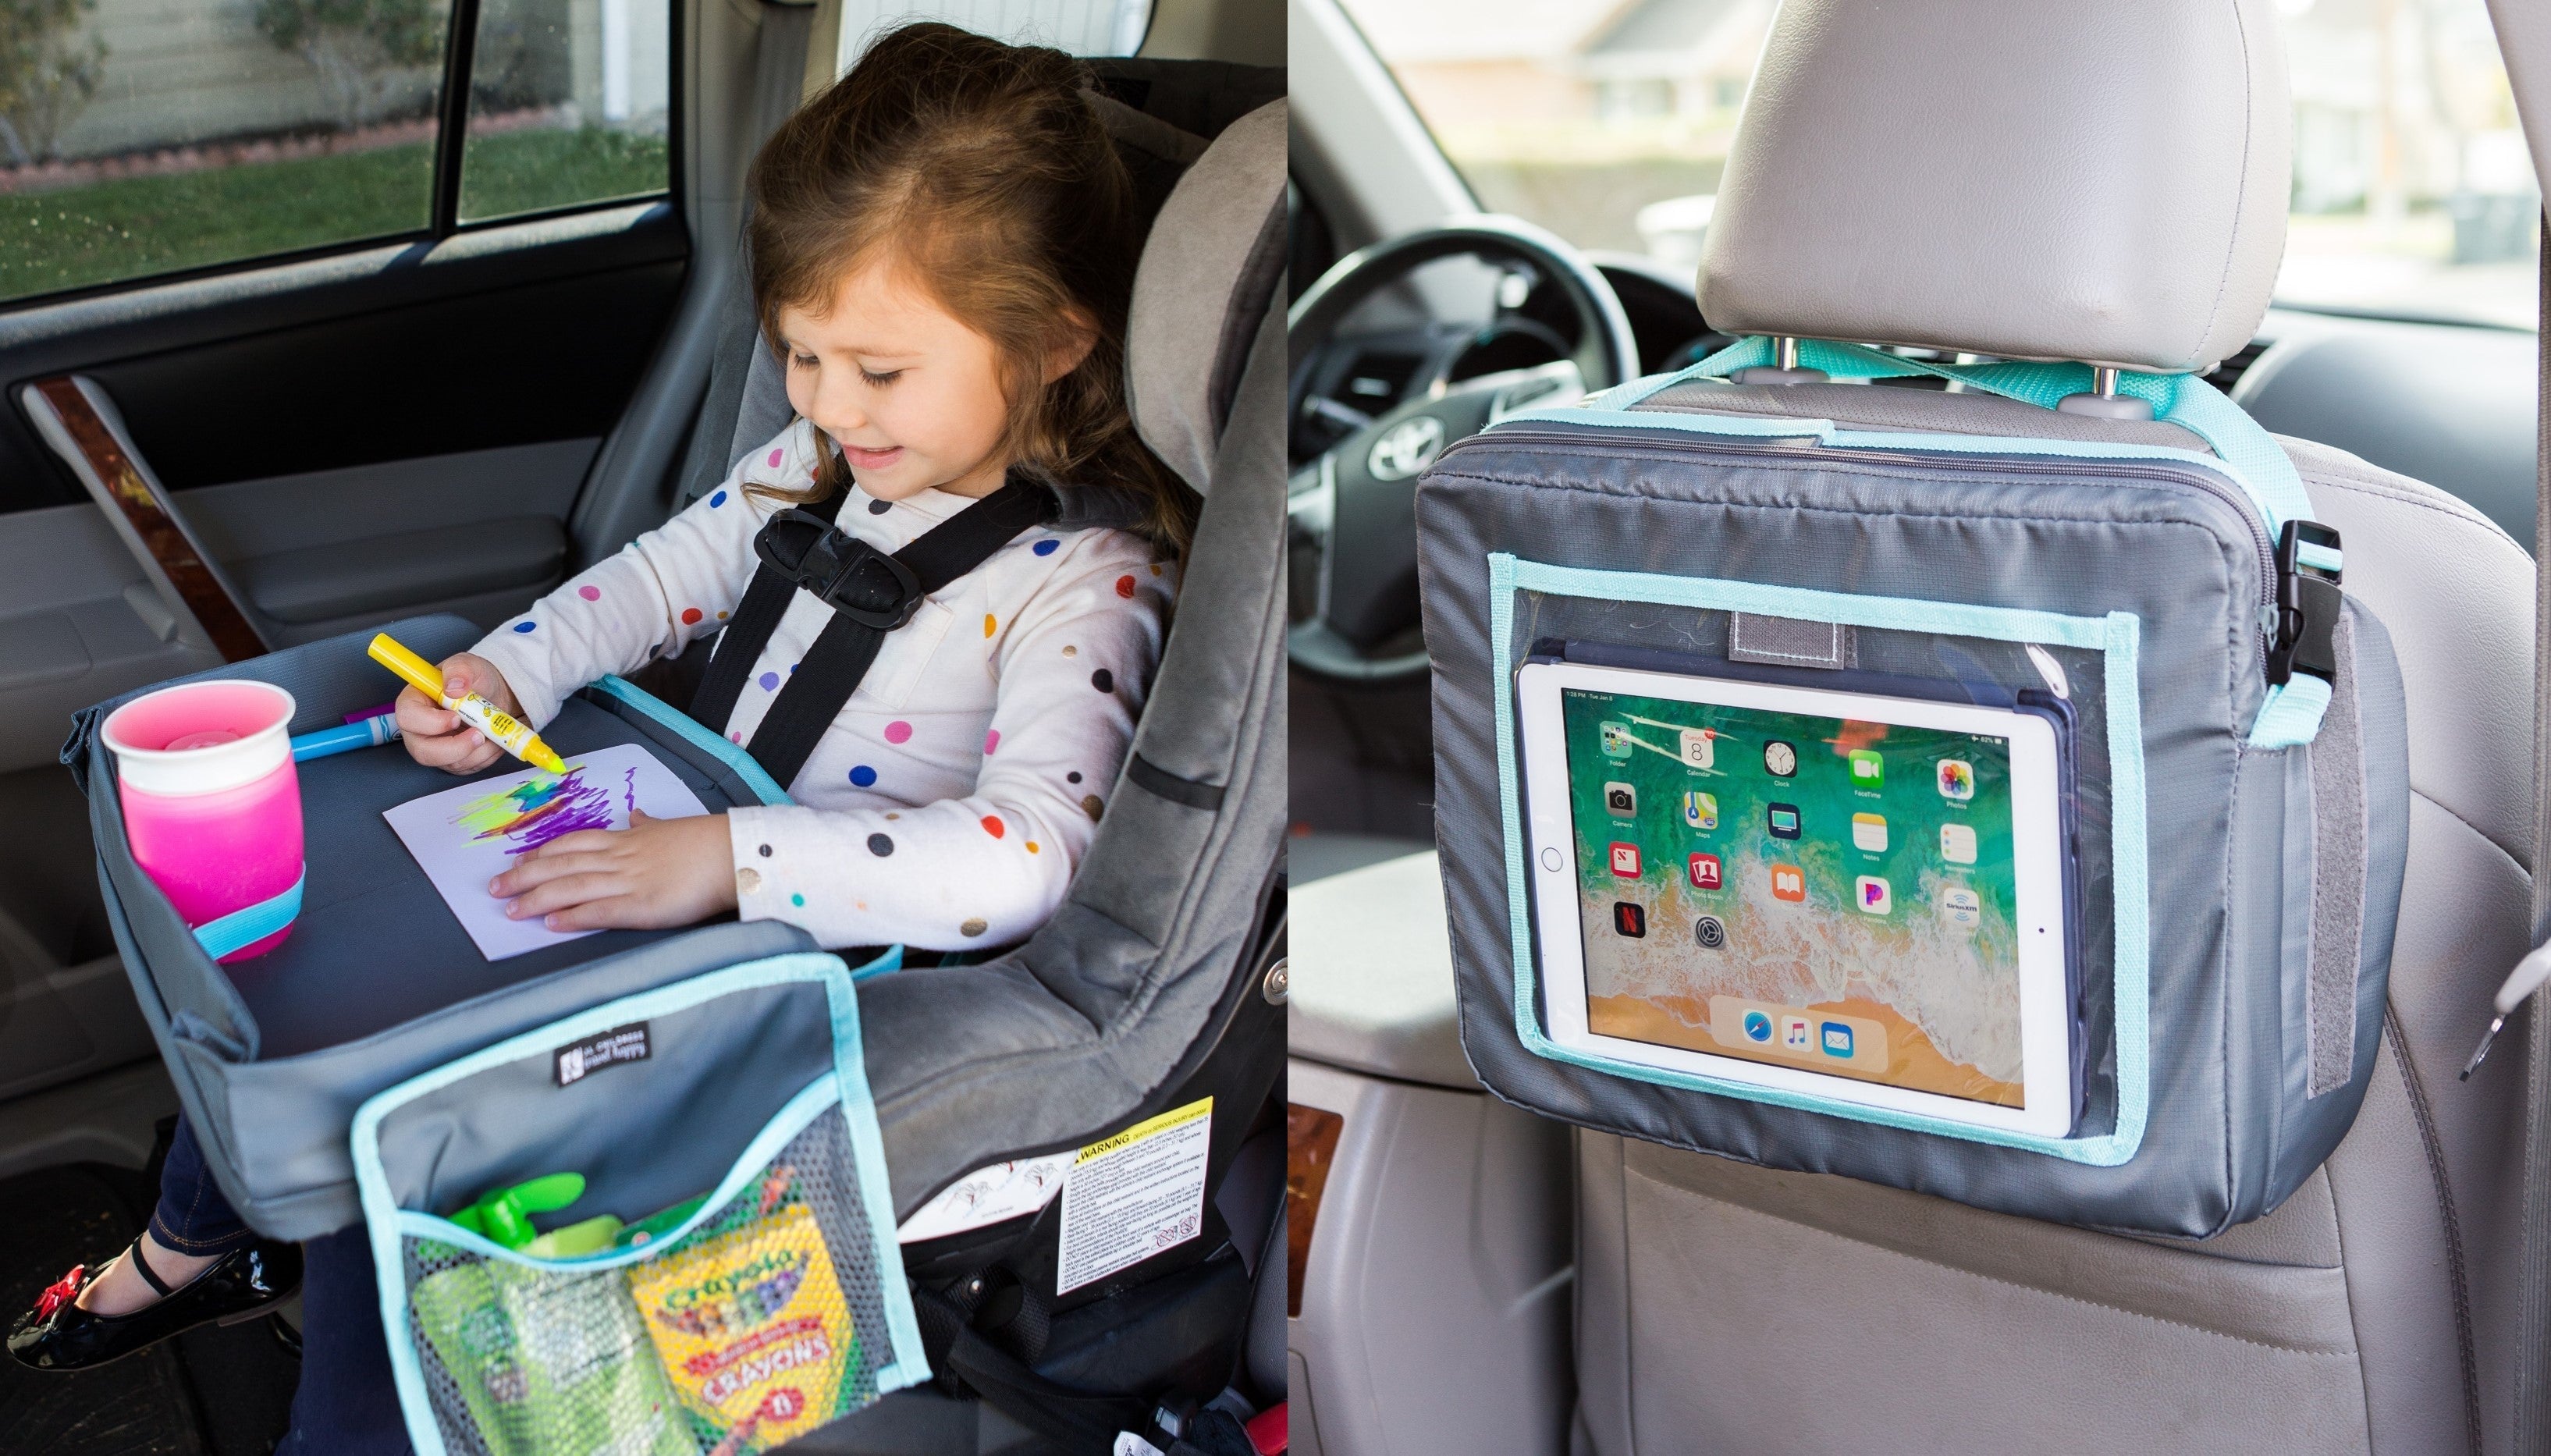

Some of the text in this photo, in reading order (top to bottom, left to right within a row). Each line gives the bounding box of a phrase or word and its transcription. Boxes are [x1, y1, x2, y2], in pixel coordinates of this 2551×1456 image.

[1685, 734, 1707, 743] Tuesday
[1691, 743, 1703, 761] 8
[1686, 769, 1711, 778] Calendar
[1774, 779, 1790, 788] Clock
[1854, 790, 1881, 799] FaceTime
[1946, 801, 1967, 810] Photos
[1612, 820, 1633, 829] Camera
[1863, 853, 1880, 861] Notes
[1081, 1134, 1130, 1160] WARNING
[666, 1251, 792, 1309] Crayola
[703, 1337, 831, 1405] CRAYONS
